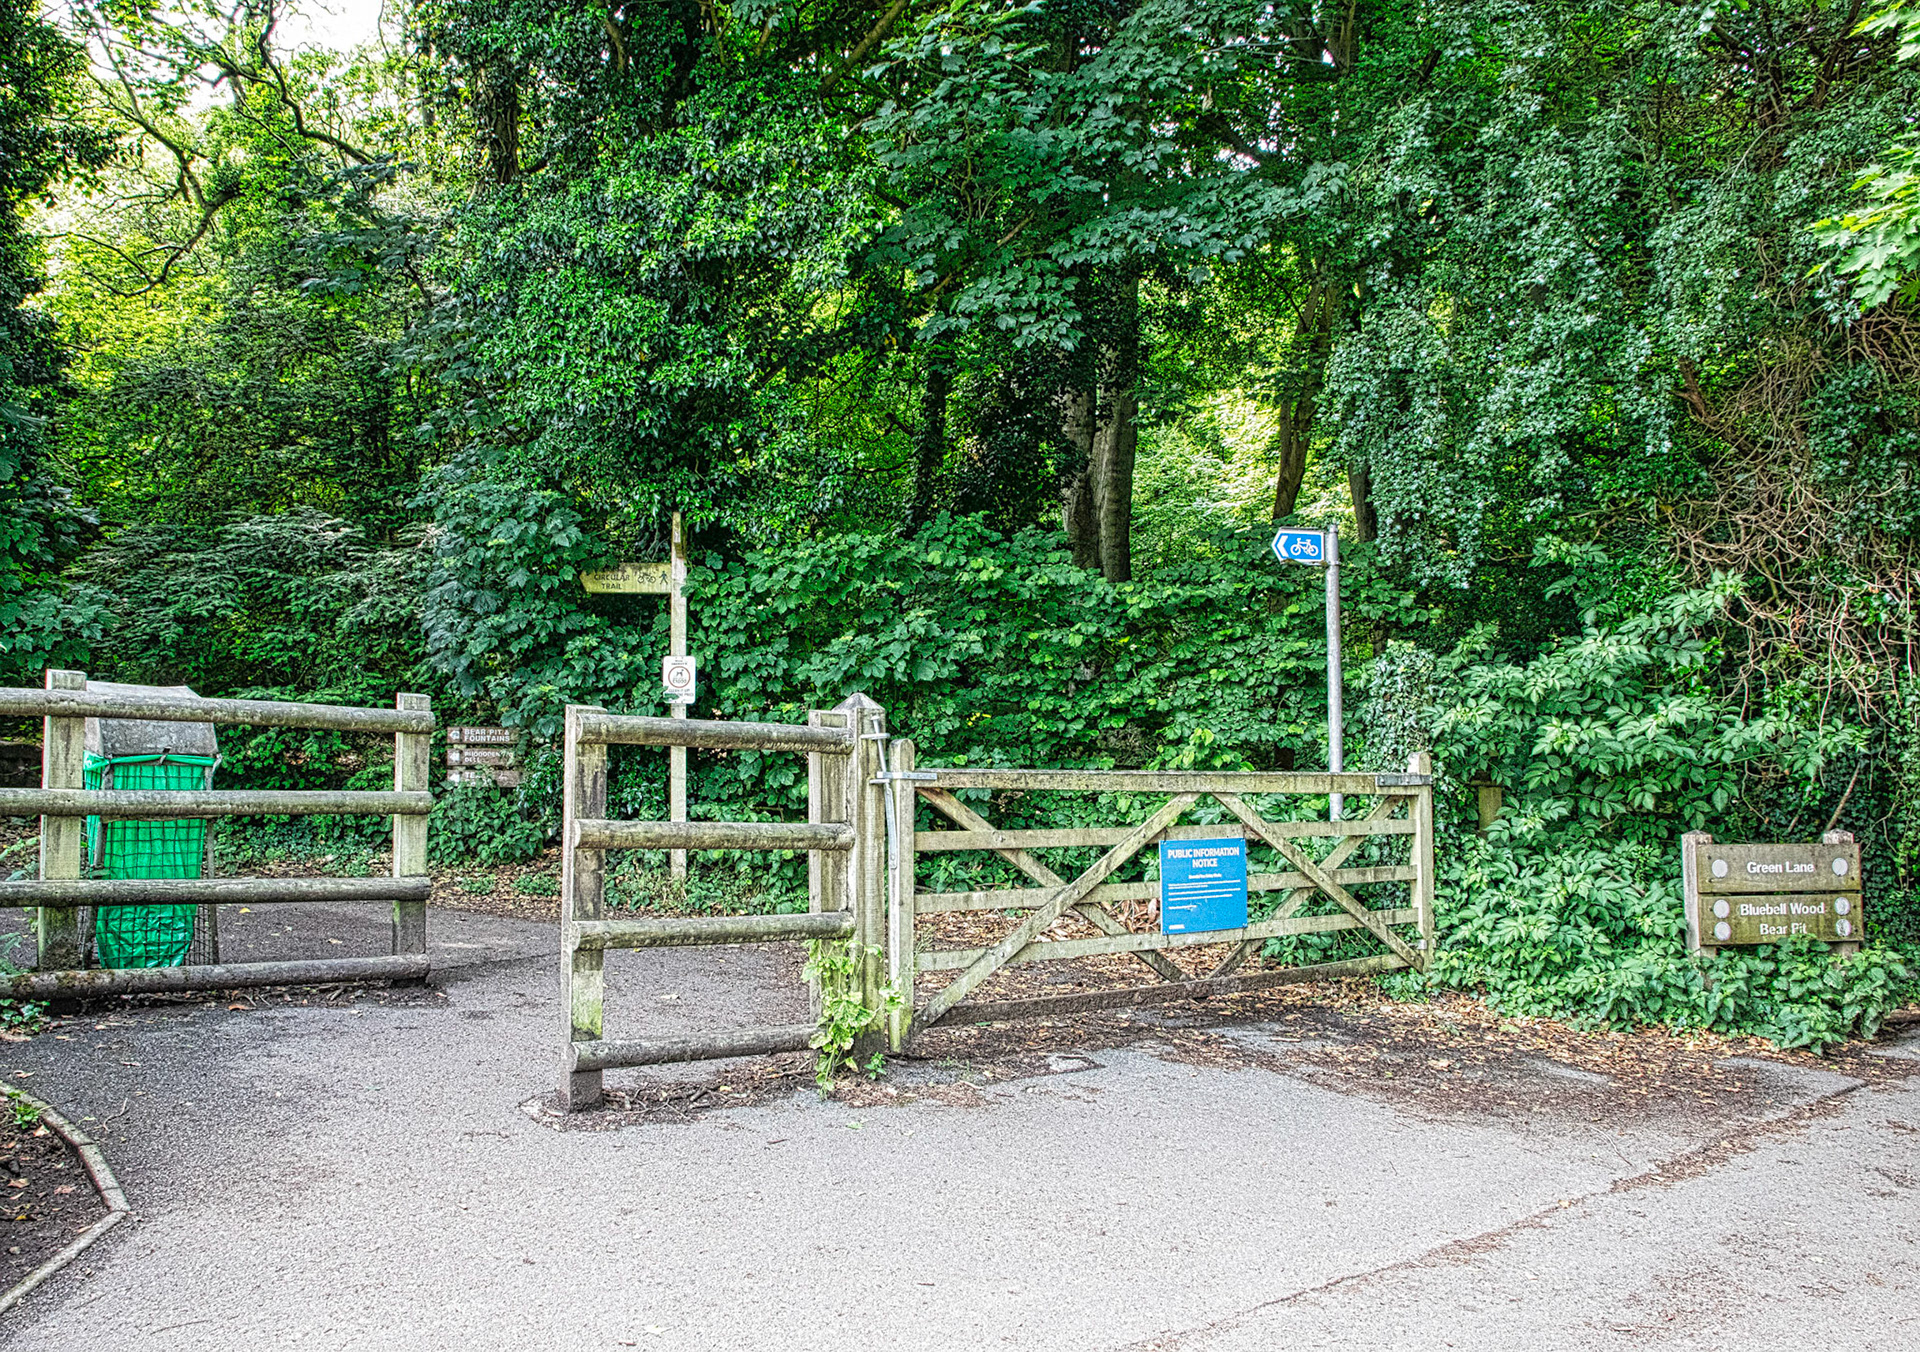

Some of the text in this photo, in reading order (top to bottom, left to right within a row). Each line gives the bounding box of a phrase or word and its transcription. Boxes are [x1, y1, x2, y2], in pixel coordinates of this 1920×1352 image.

[464, 728, 486, 736] BEAR
[1167, 846, 1240, 859] PUBLIC INFORMATION
[1192, 858, 1218, 867] NOTICE
[1746, 861, 1815, 874] Green Lane
[1740, 902, 1826, 916] Bluebell Wood
[1759, 922, 1807, 936] Bear Pit
